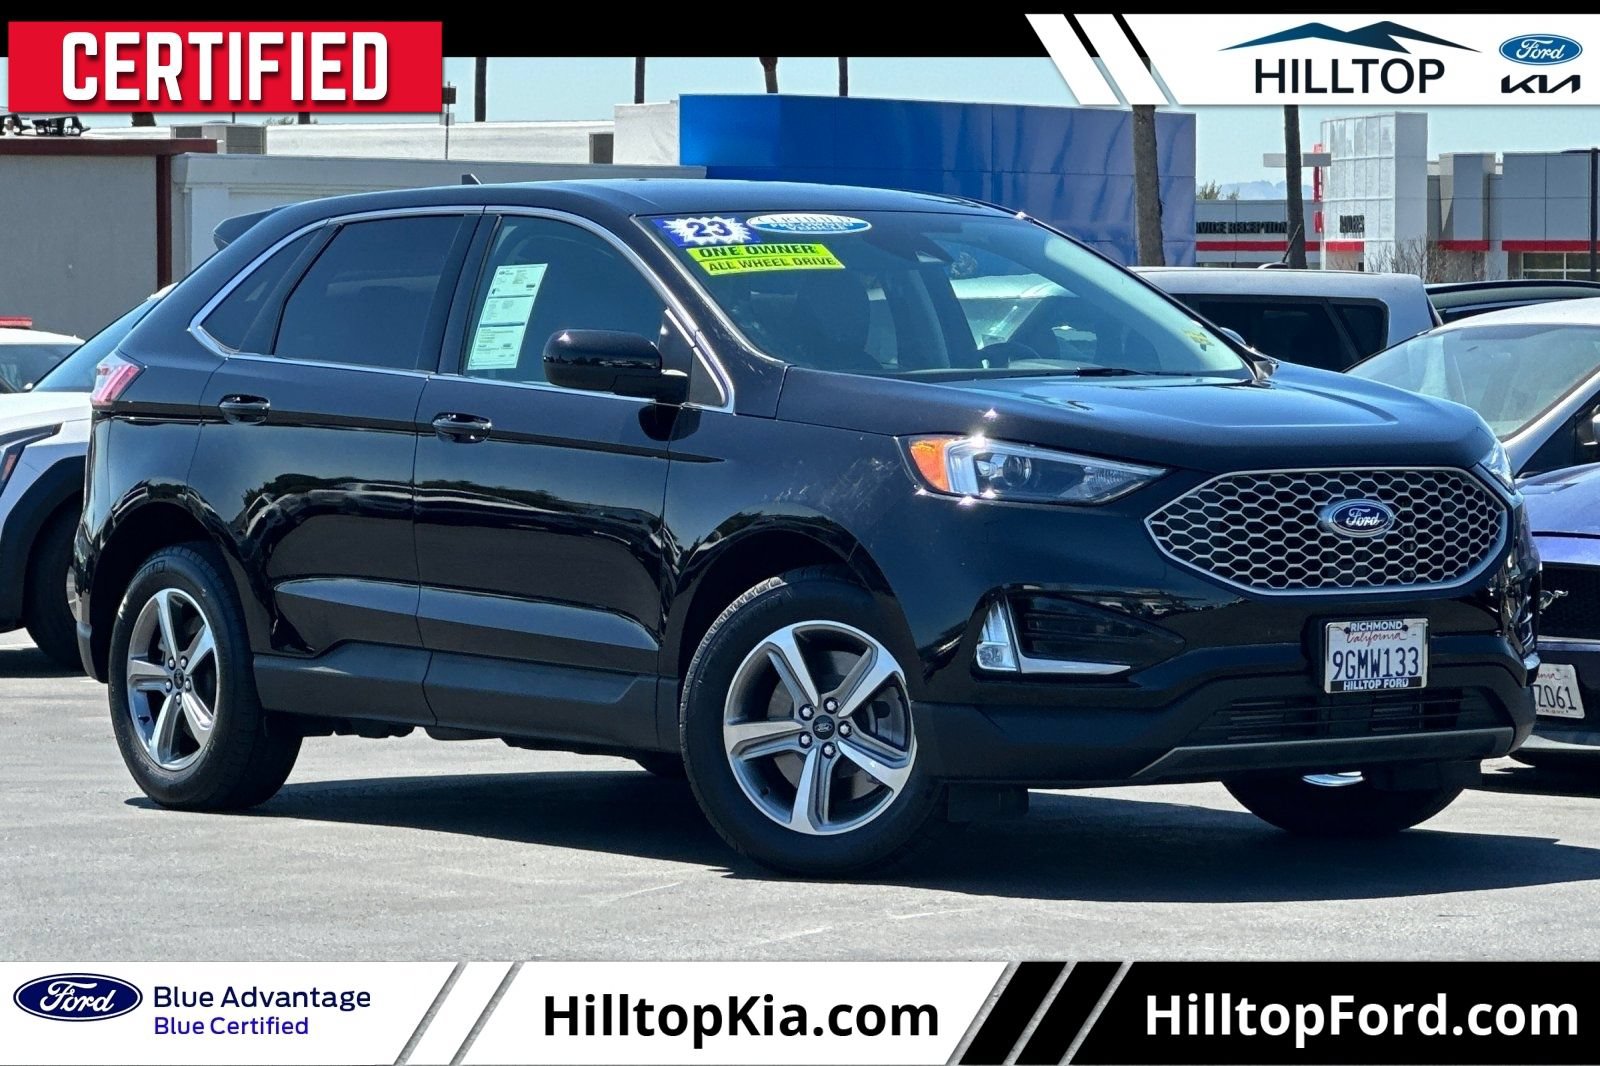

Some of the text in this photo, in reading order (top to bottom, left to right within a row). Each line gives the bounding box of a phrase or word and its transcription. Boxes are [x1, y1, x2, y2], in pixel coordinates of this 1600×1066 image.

[686, 220, 733, 238] 23
[1228, 221, 1288, 234] RECEPTION
[699, 244, 817, 258] ONE OWNER
[709, 256, 836, 272] ALL WHEEL DRIVE
[1346, 507, 1382, 526] Ford
[1350, 620, 1403, 632] RICHMOND
[1346, 631, 1403, 647] California
[1332, 646, 1419, 680] 9GMW133
[1343, 678, 1409, 691] HILLTOP FORD
